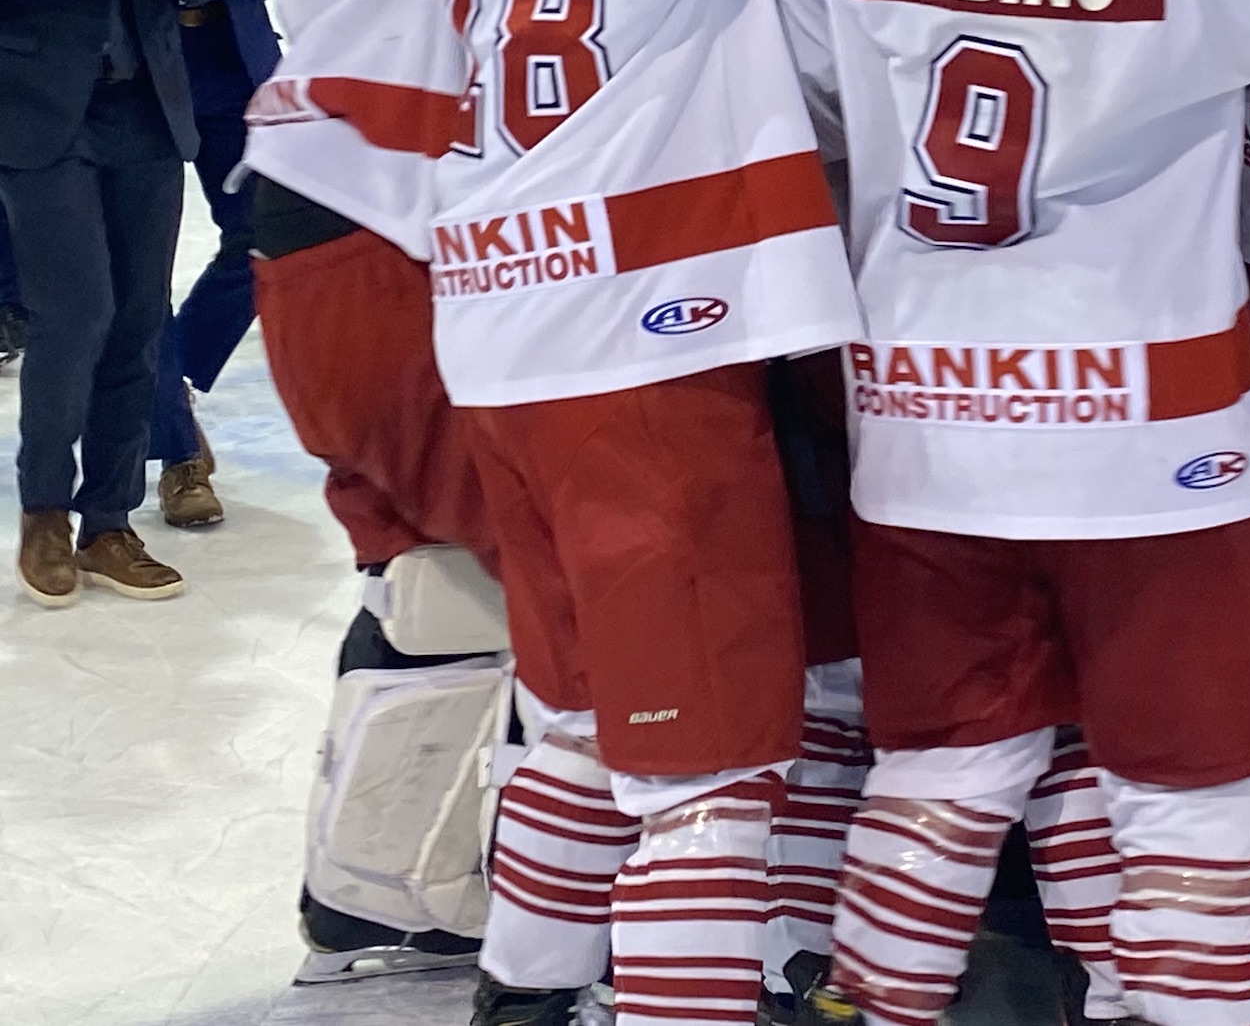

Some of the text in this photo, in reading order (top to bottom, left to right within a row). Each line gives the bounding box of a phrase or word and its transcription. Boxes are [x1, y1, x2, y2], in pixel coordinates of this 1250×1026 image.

[898, 33, 1049, 251] 9
[434, 201, 592, 266] NKIN
[647, 298, 727, 331] AK
[849, 342, 1128, 390] RANKIN
[856, 384, 1131, 424] CONSTRUCTION
[1180, 452, 1248, 485] AK
[628, 708, 679, 725] BAUER
